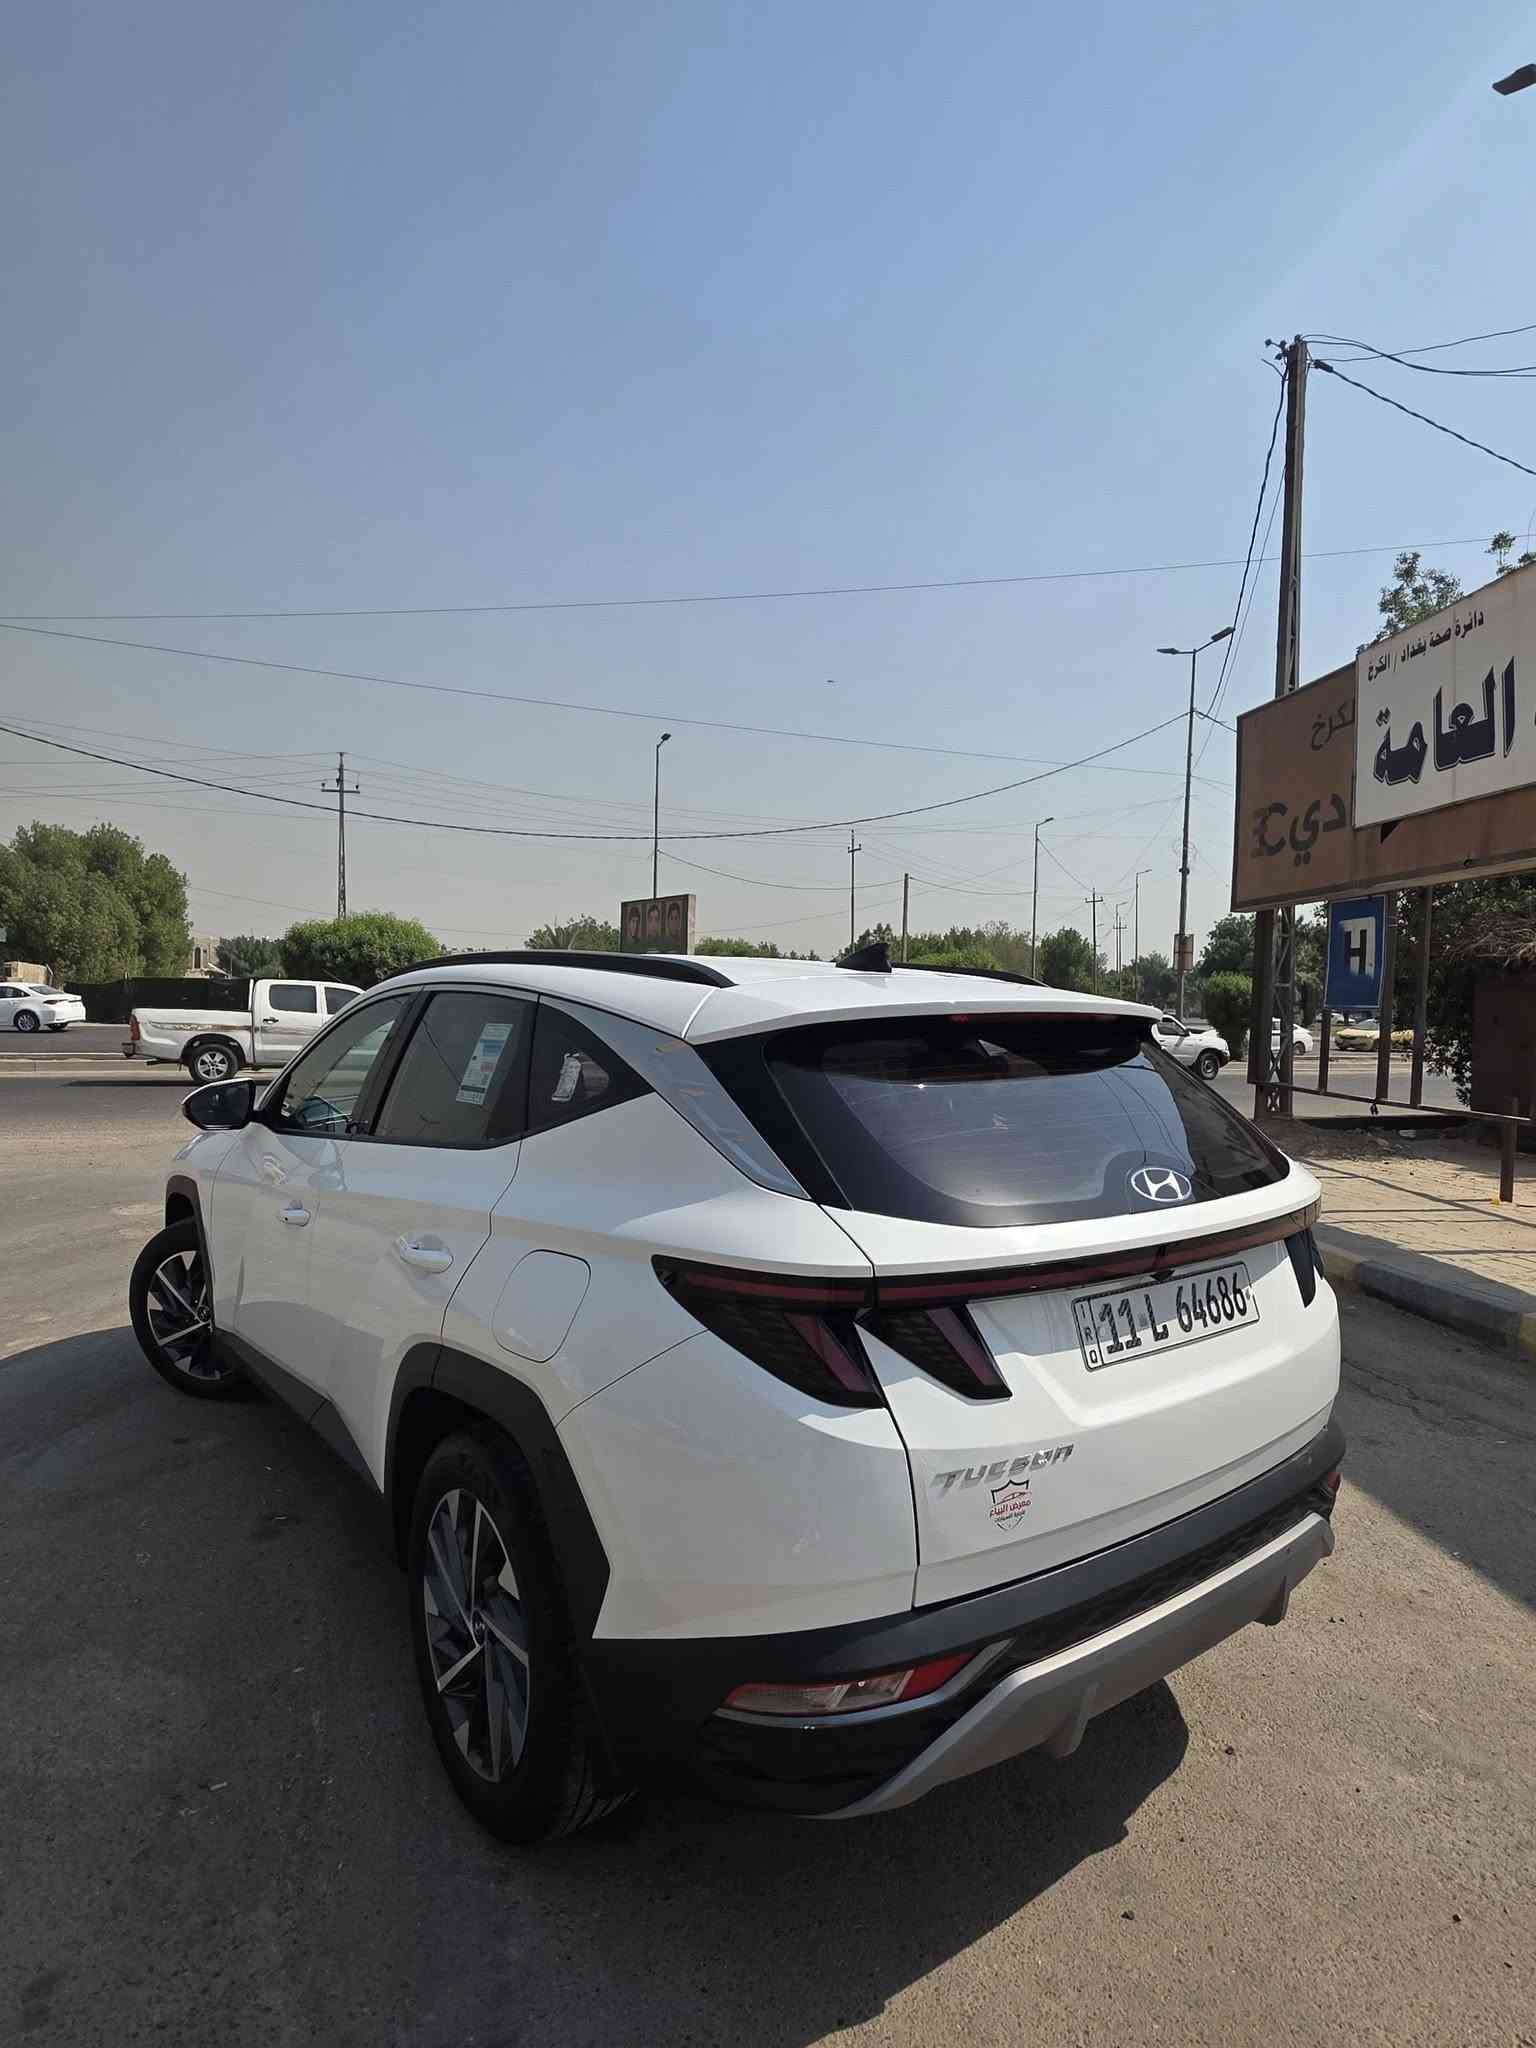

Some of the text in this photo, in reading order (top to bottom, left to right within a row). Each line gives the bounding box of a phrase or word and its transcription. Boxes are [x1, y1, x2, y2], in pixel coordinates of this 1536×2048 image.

[1401, 637, 1427, 662] بغداد
[1429, 627, 1451, 648] صحة
[1368, 653, 1391, 683] الكرخ
[1311, 700, 1356, 751] لكرخ
[1373, 656, 1516, 786] العامة
[1344, 928, 1368, 974] H
[1100, 1271, 1248, 1354] 11 L 64686
[931, 1443, 1074, 1488] TUCSON
